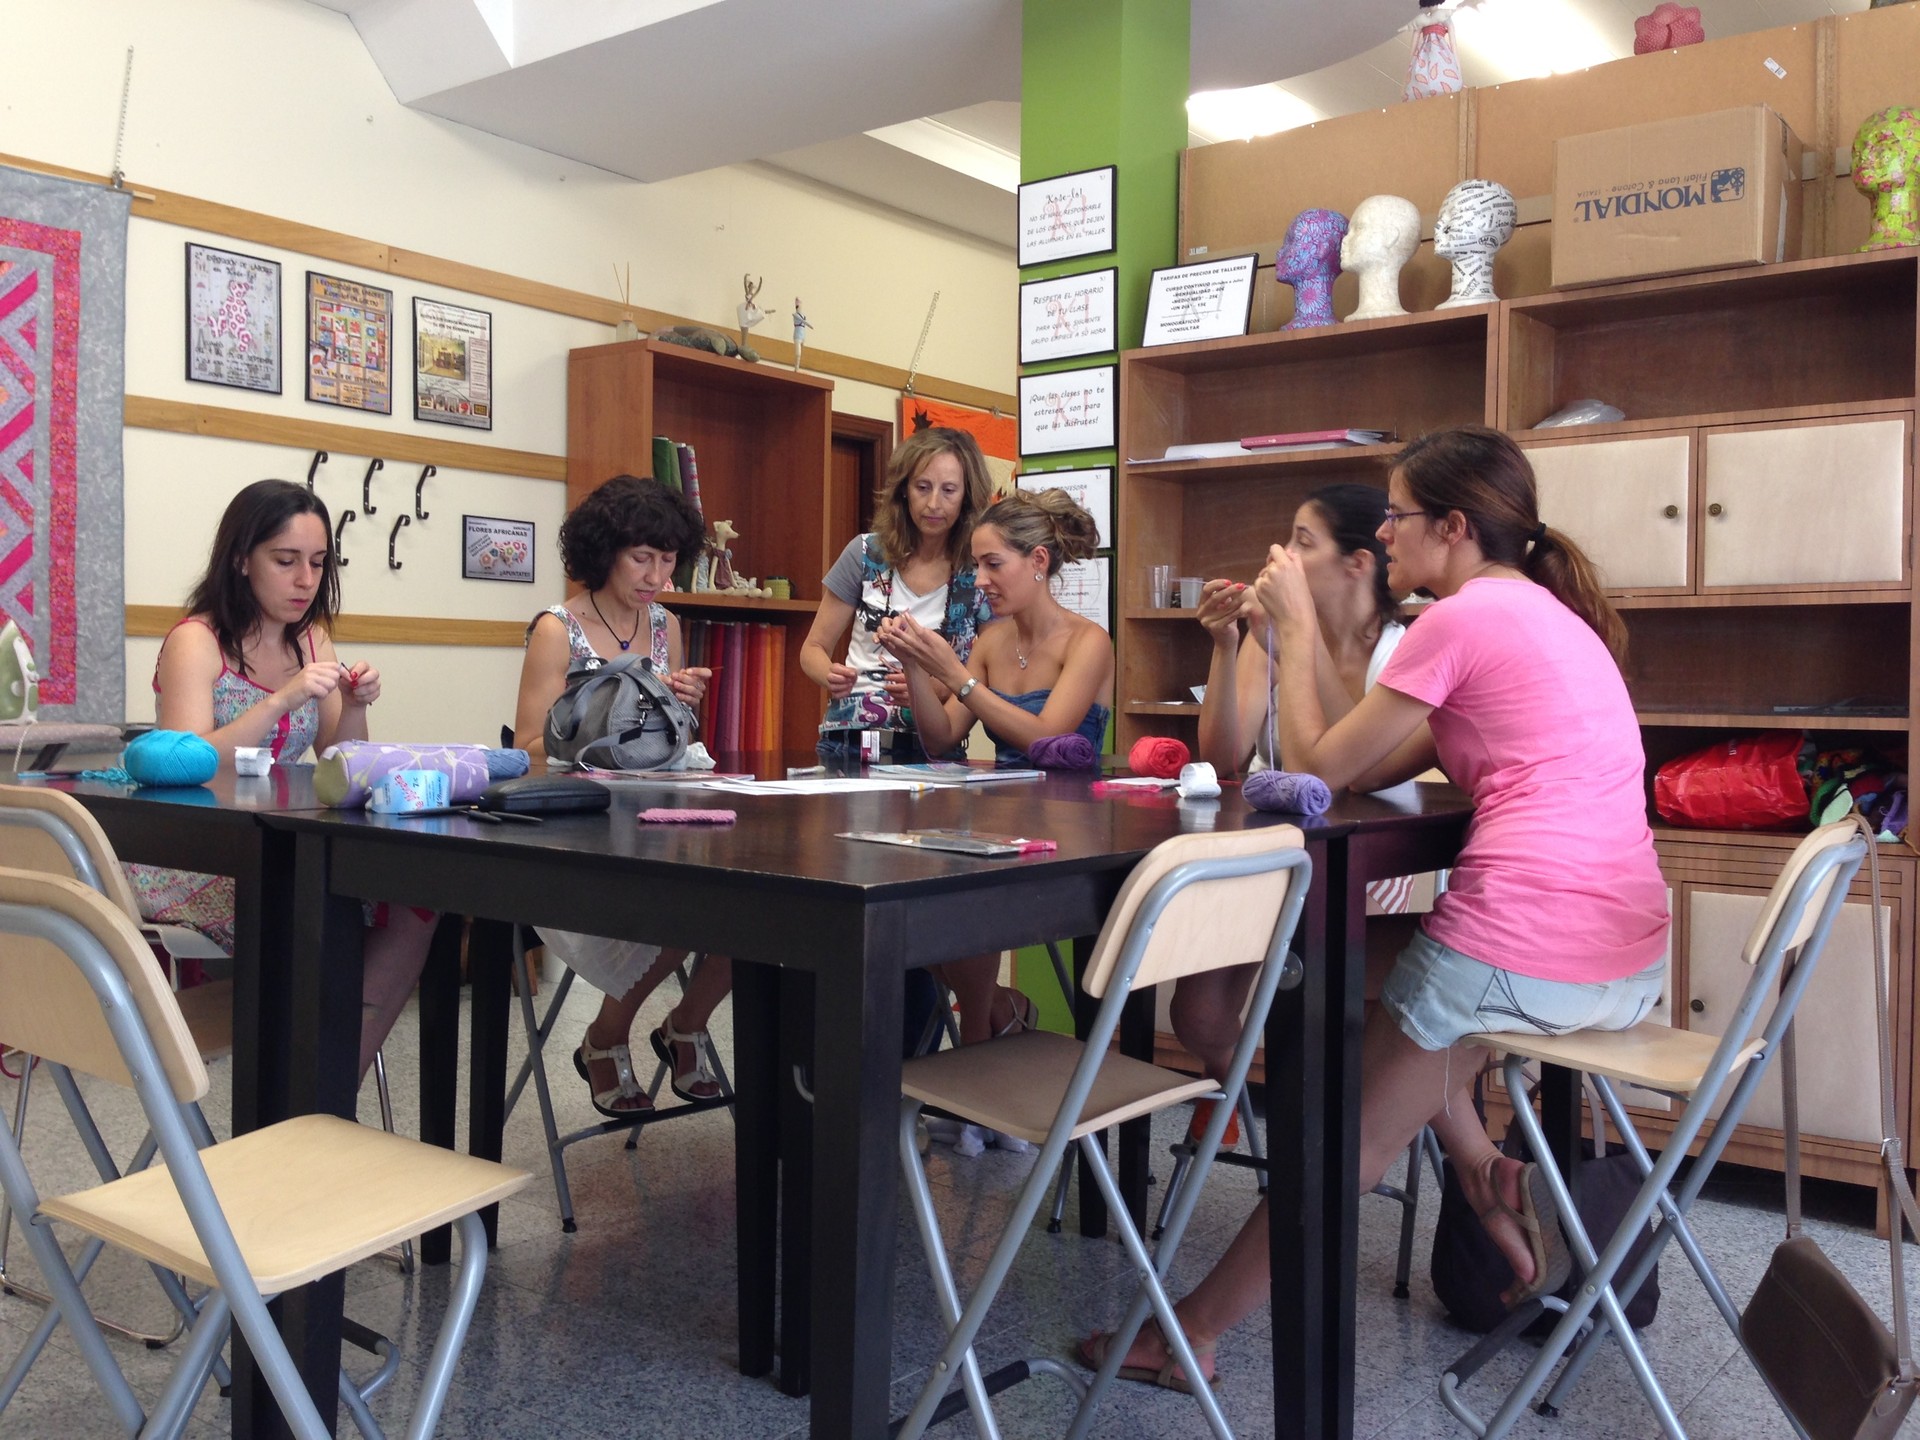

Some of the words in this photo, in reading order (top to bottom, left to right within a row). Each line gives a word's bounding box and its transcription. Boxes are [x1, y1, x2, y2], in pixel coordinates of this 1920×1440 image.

[1658, 176, 1680, 186] Lana
[1611, 182, 1644, 194] Cotone
[1574, 182, 1707, 222] MONDIAL
[1084, 227, 1106, 237] TALLER
[1160, 274, 1180, 282] TARIFAS
[1189, 269, 1212, 277] PRECIOS
[1220, 265, 1247, 274] TALLERES
[1074, 286, 1104, 298] HORARIO
[1165, 284, 1183, 292] CURSO
[1183, 281, 1211, 290] CONTINUO
[1060, 389, 1081, 399] clases
[1083, 388, 1093, 396] no
[1069, 404, 1082, 412] son
[1083, 402, 1101, 412] para
[1035, 424, 1048, 433] que
[468, 525, 493, 534] FLORES
[493, 528, 528, 537] AFRICANAS
